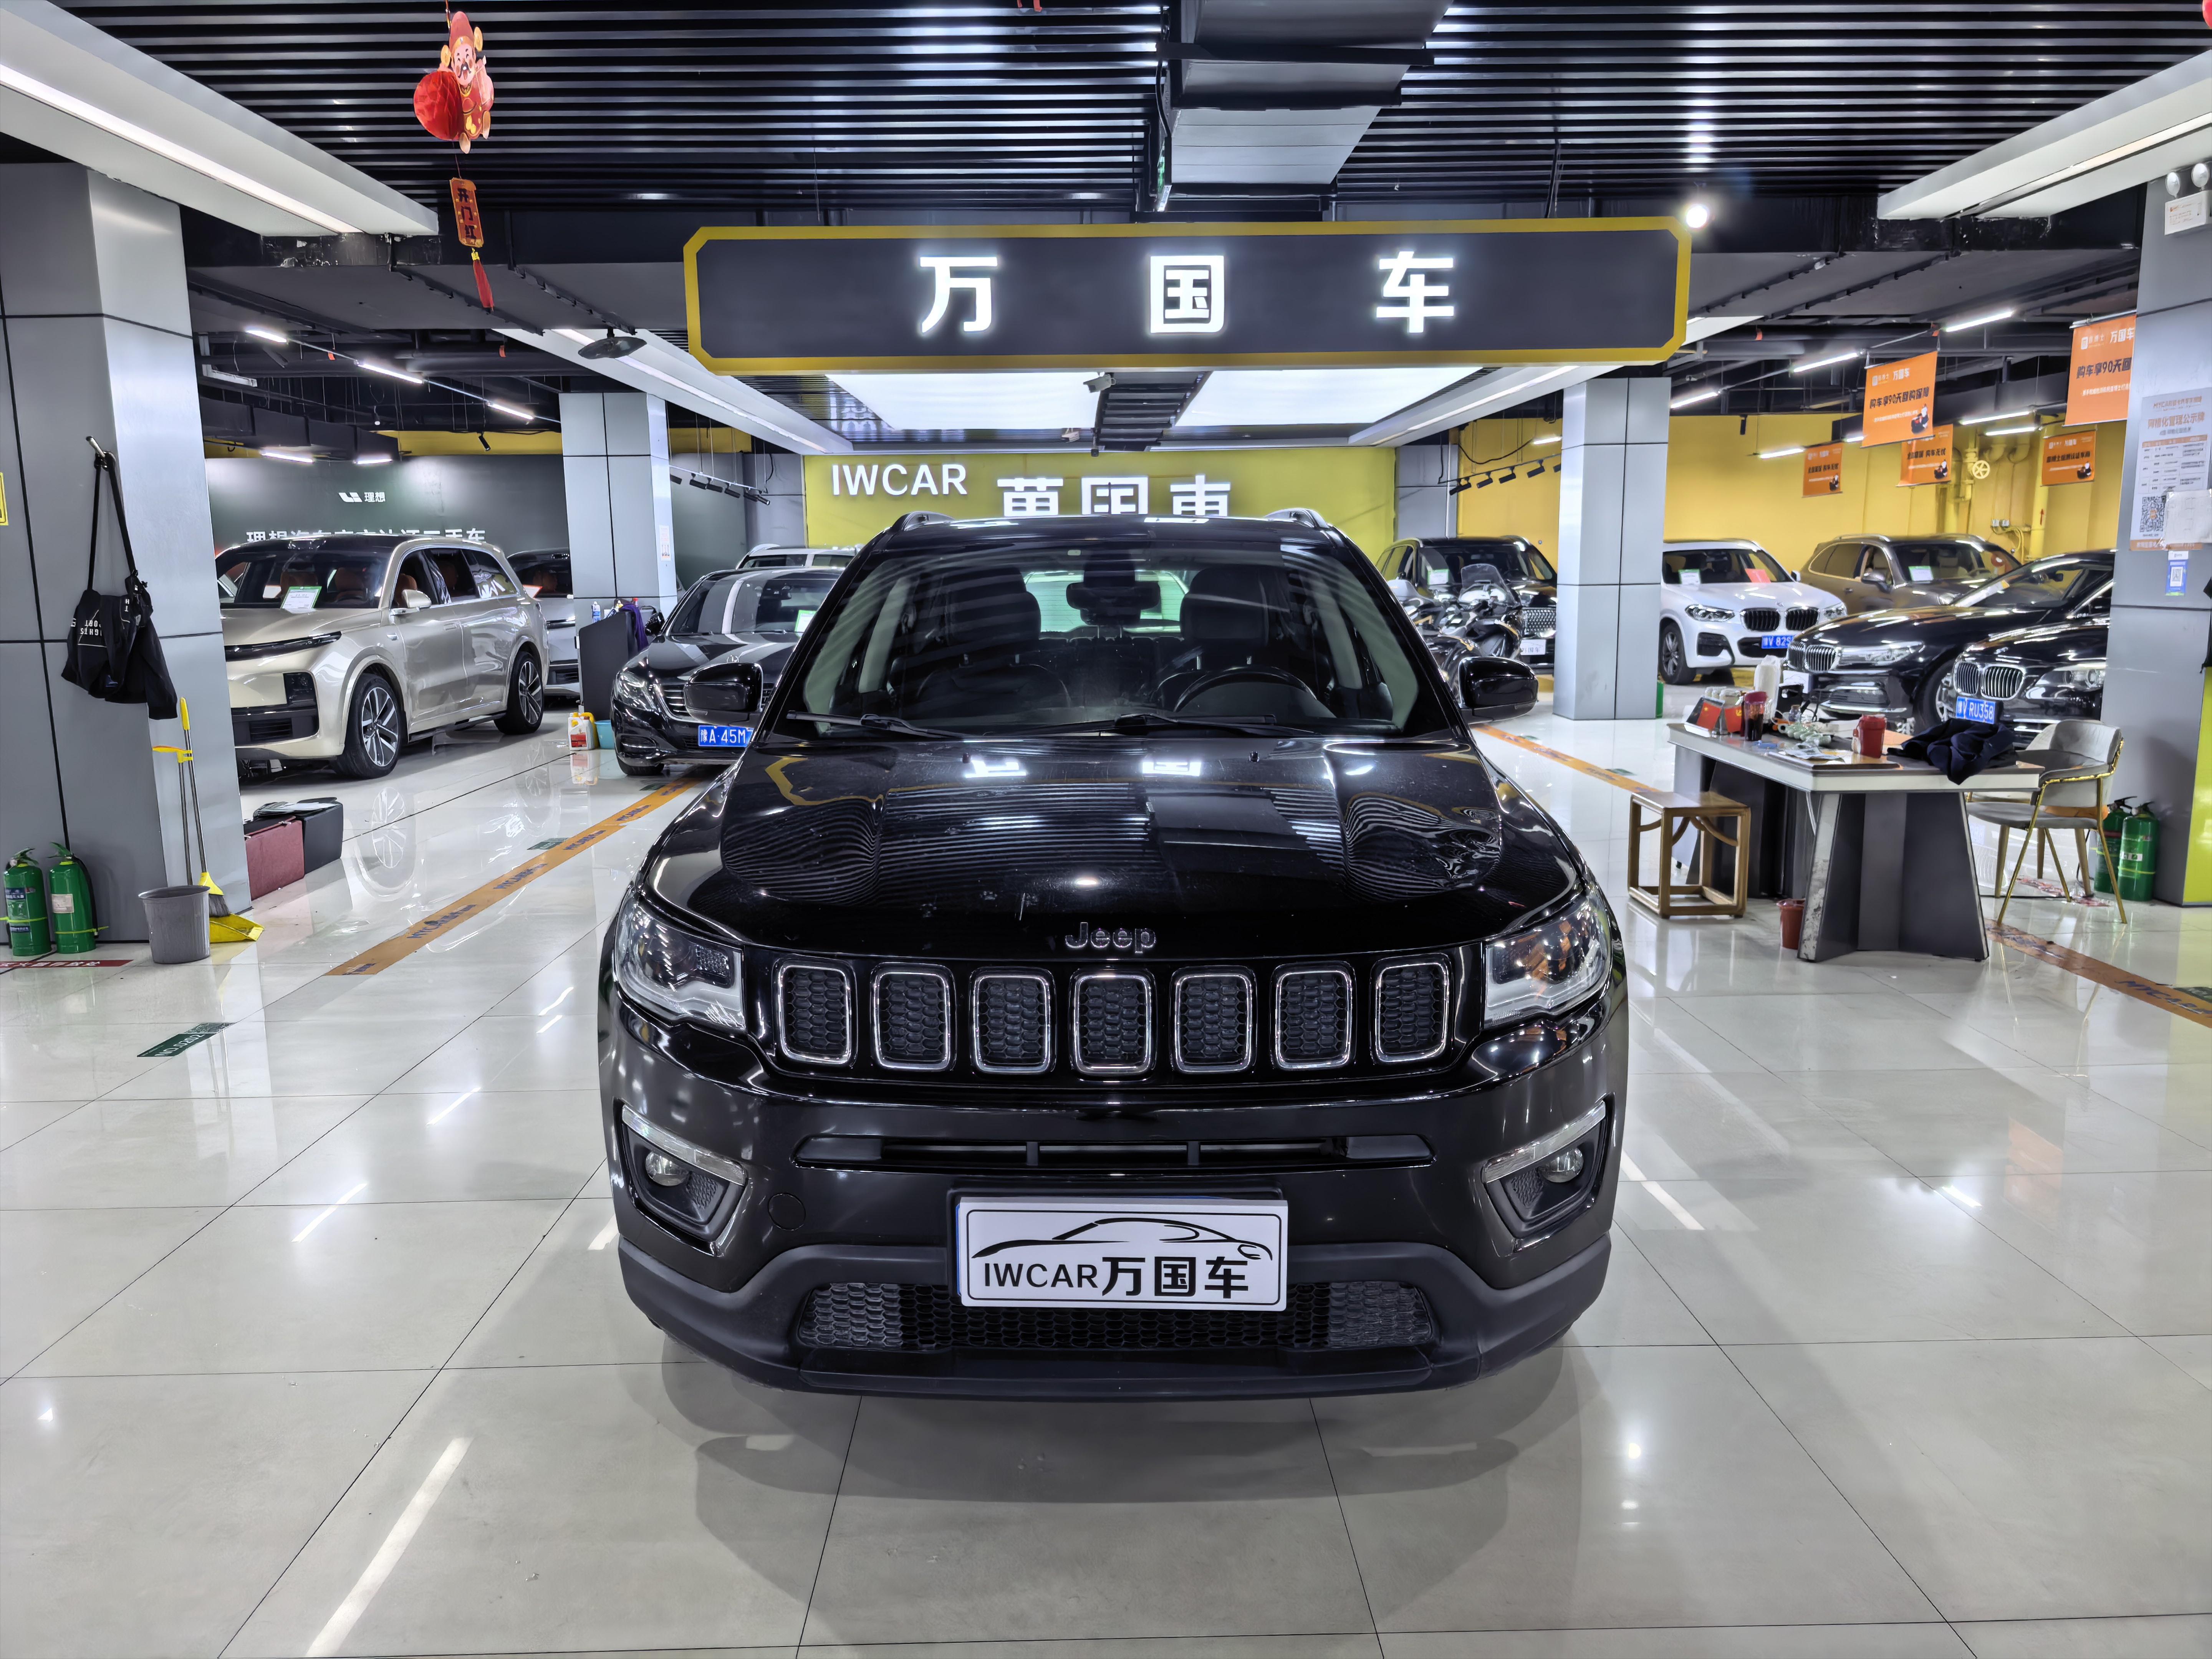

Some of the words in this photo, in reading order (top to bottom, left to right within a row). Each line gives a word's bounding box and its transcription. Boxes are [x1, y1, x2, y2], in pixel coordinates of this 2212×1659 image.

[920, 251, 1454, 334] 万国车
[832, 464, 967, 496] IWCAR
[364, 492, 386, 502] 理想
[1065, 922, 1156, 954] Jeep
[154, 1034, 205, 1056] NO.0202
